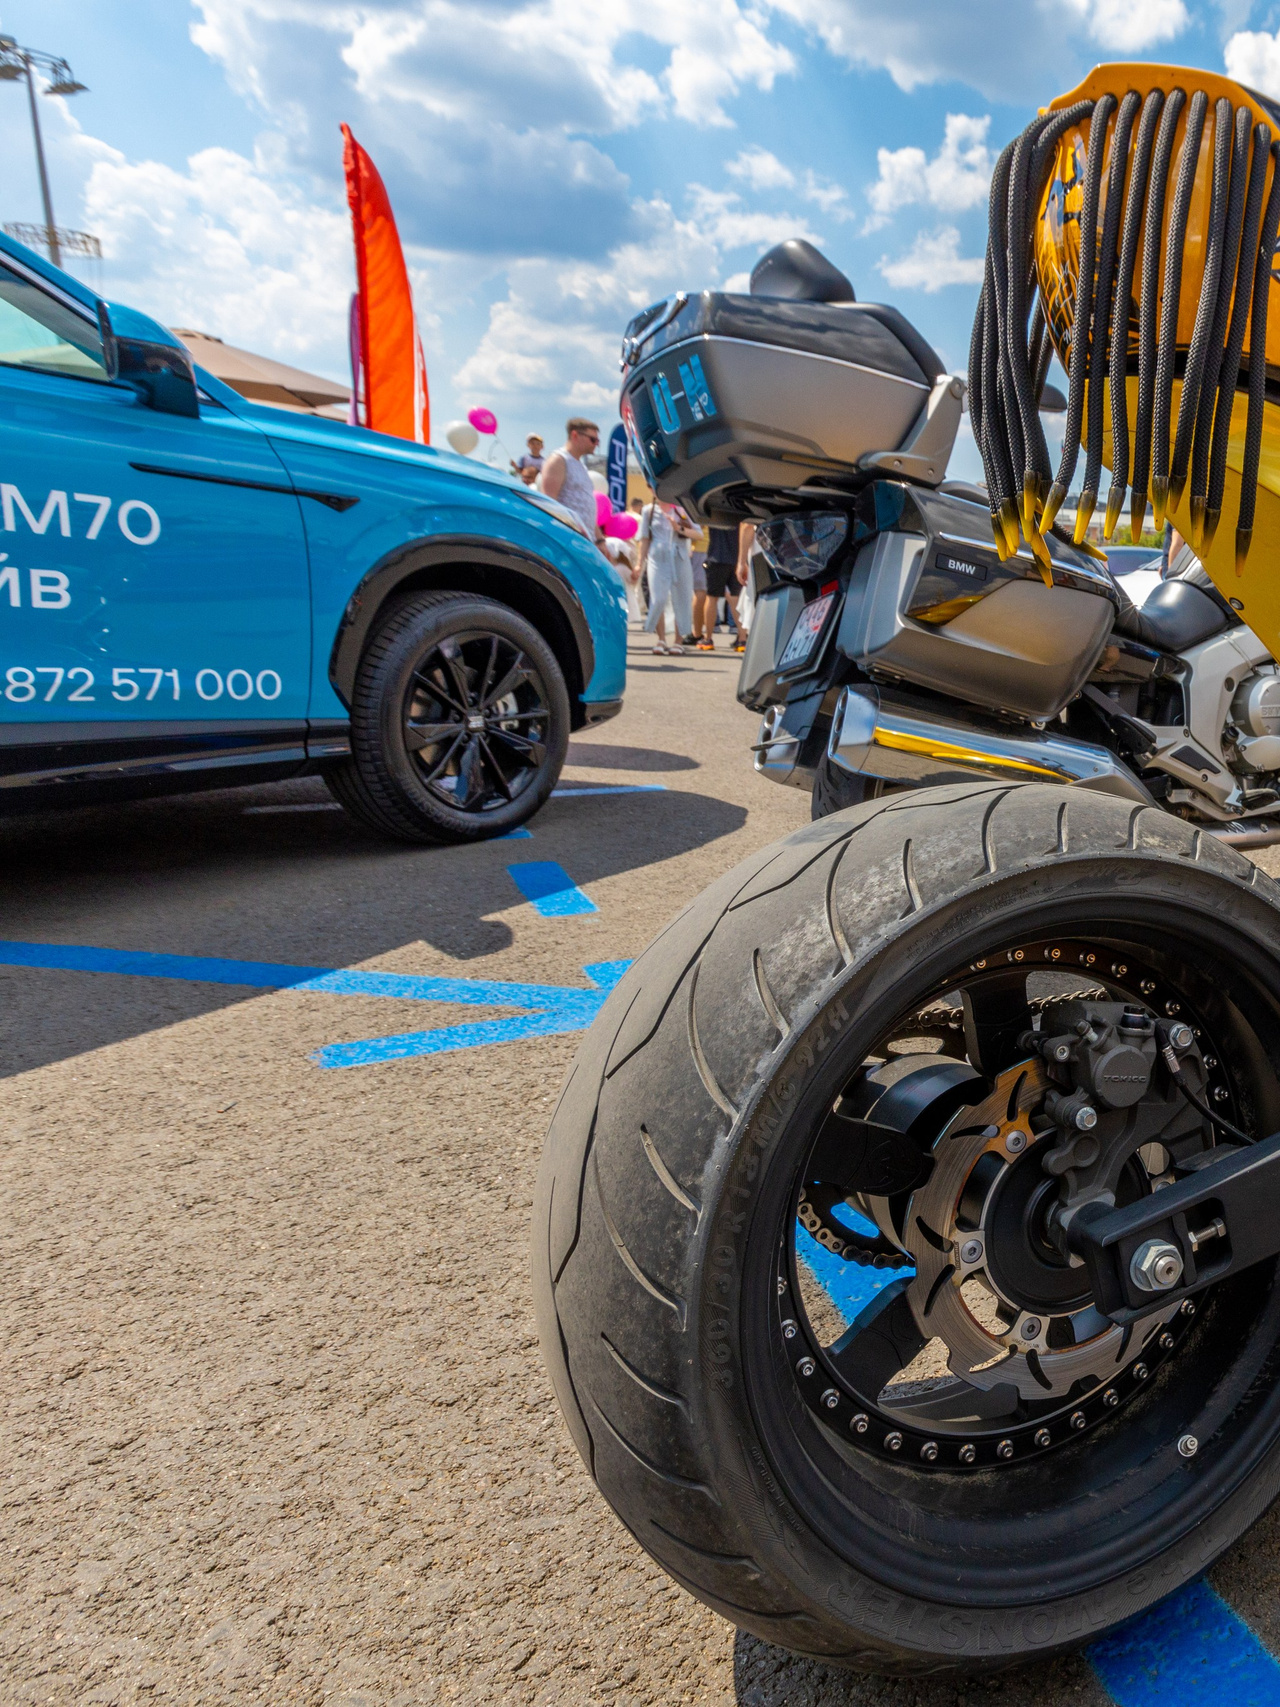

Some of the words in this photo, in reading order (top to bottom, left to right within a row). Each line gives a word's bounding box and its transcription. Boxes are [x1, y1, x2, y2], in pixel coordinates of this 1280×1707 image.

[0, 482, 161, 545] M70
[948, 559, 976, 575] BMW
[0, 666, 95, 702] 872
[111, 667, 180, 701] 571
[195, 668, 281, 700] 000
[1103, 1075, 1147, 1083] TOKICO
[826, 1568, 1109, 1650] MONSTER
